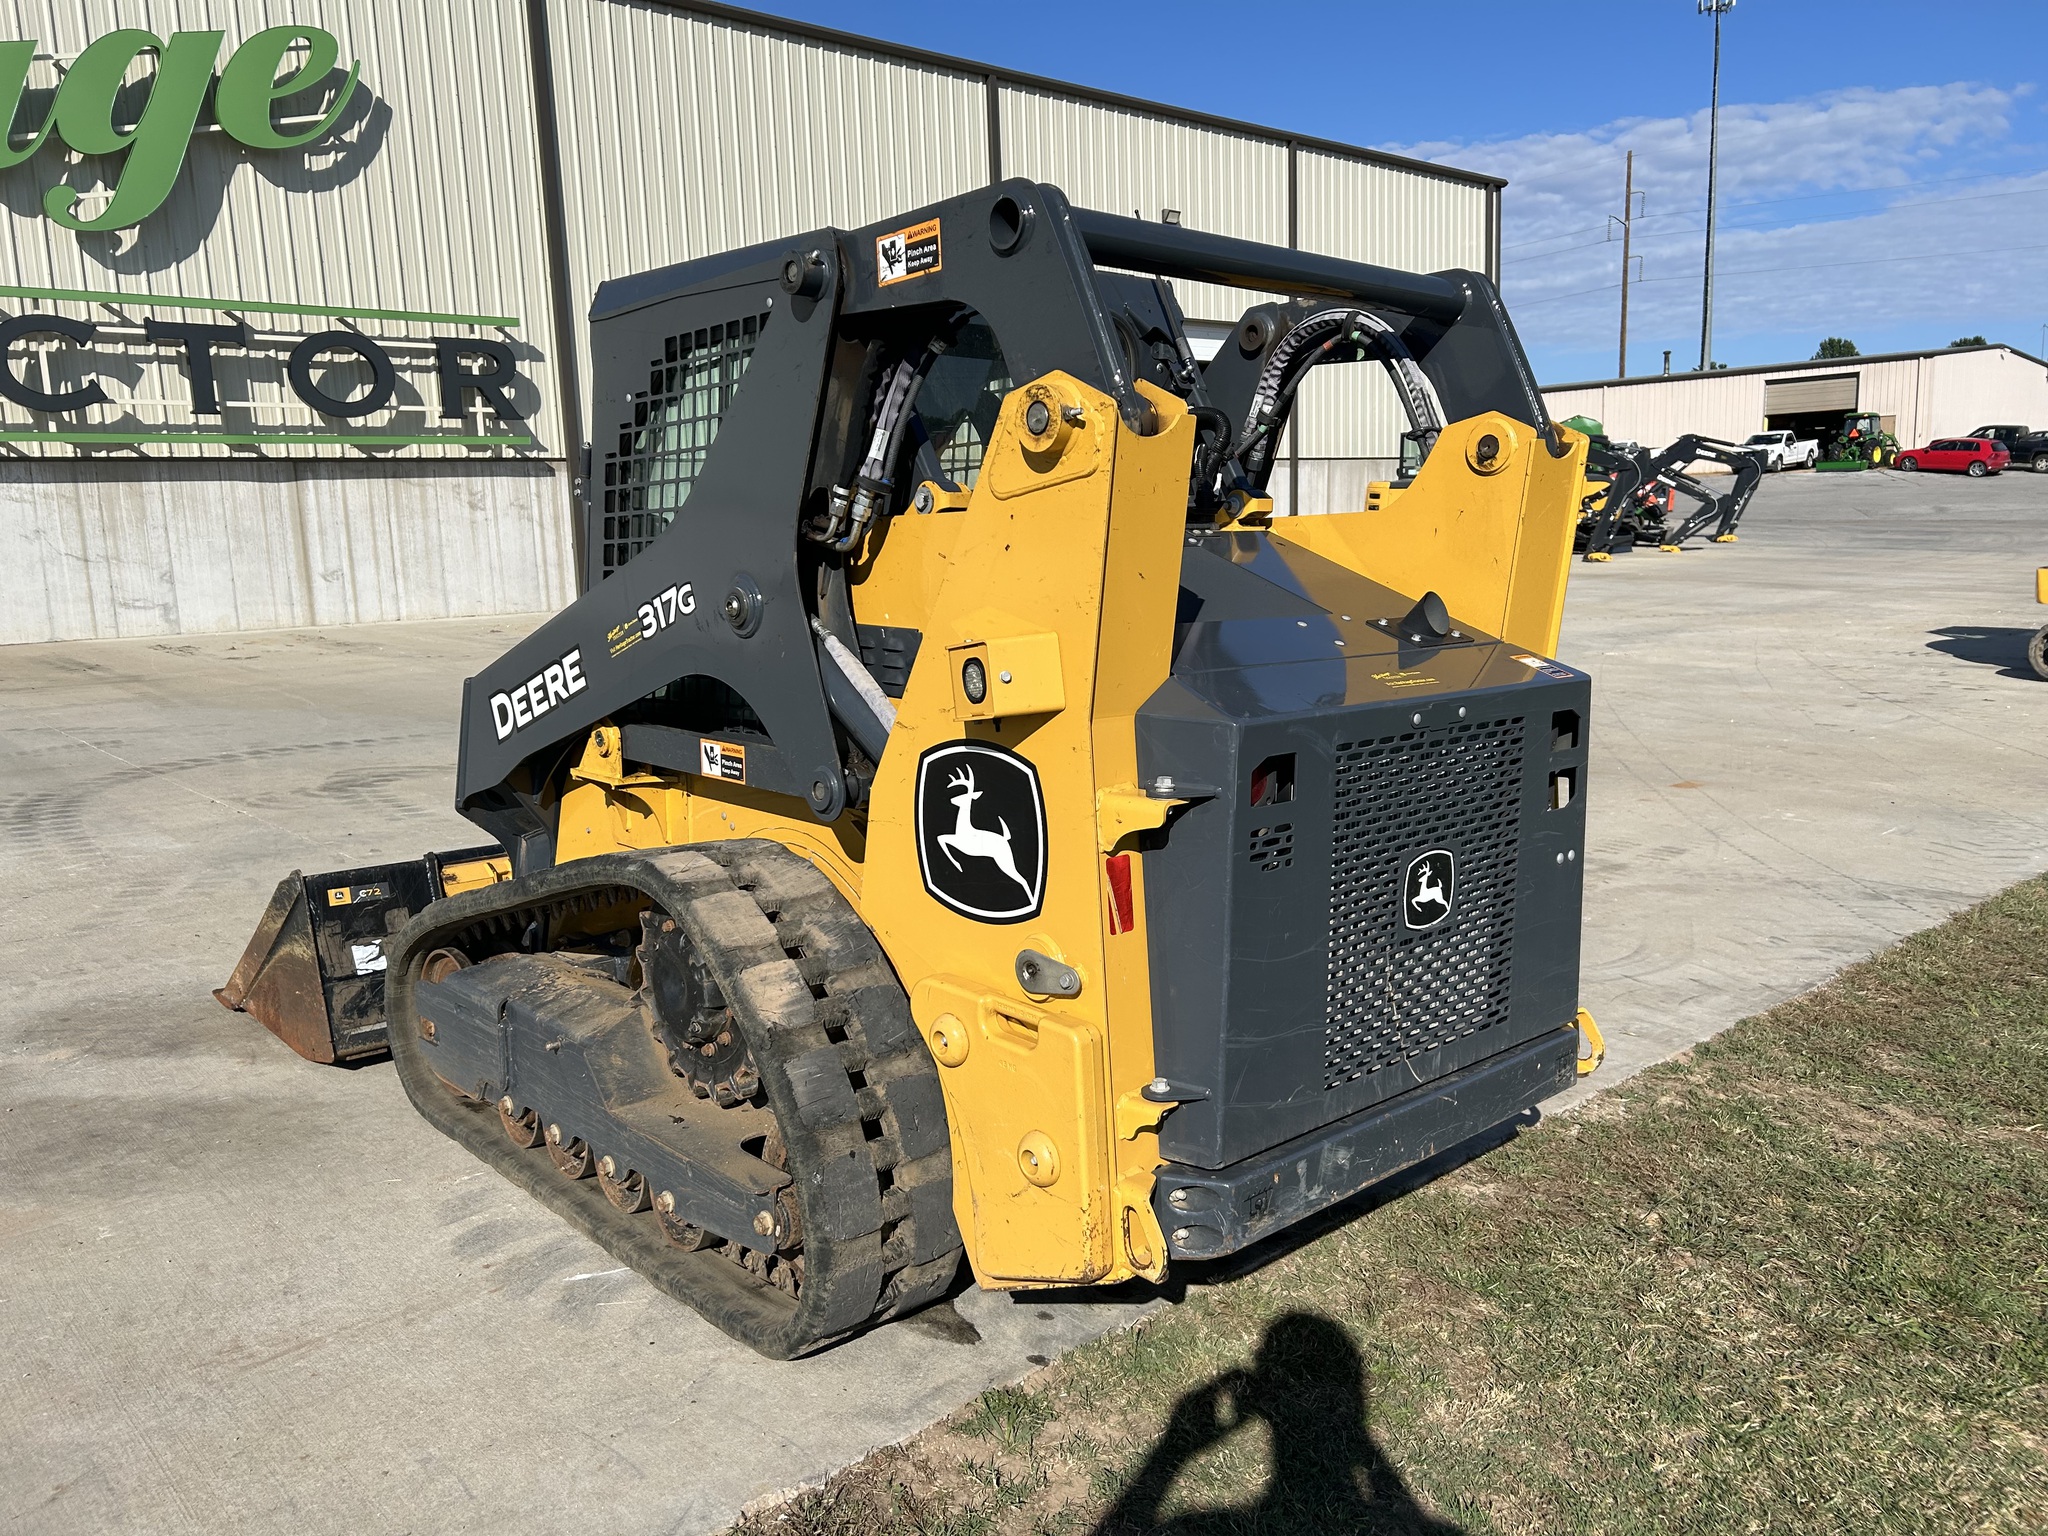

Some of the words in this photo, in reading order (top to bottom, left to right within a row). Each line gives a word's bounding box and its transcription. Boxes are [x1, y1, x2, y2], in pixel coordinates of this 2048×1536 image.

[911, 224, 937, 238] WARNING
[907, 246, 923, 258] Pinch
[923, 243, 937, 253] Area
[907, 258, 920, 268] Keep
[920, 256, 933, 265] Away
[637, 583, 696, 639] 317G
[490, 648, 587, 740] DEERE
[725, 747, 743, 755] WARNING
[721, 758, 733, 767] Pinch
[733, 761, 743, 769] Area
[731, 769, 740, 777] Away
